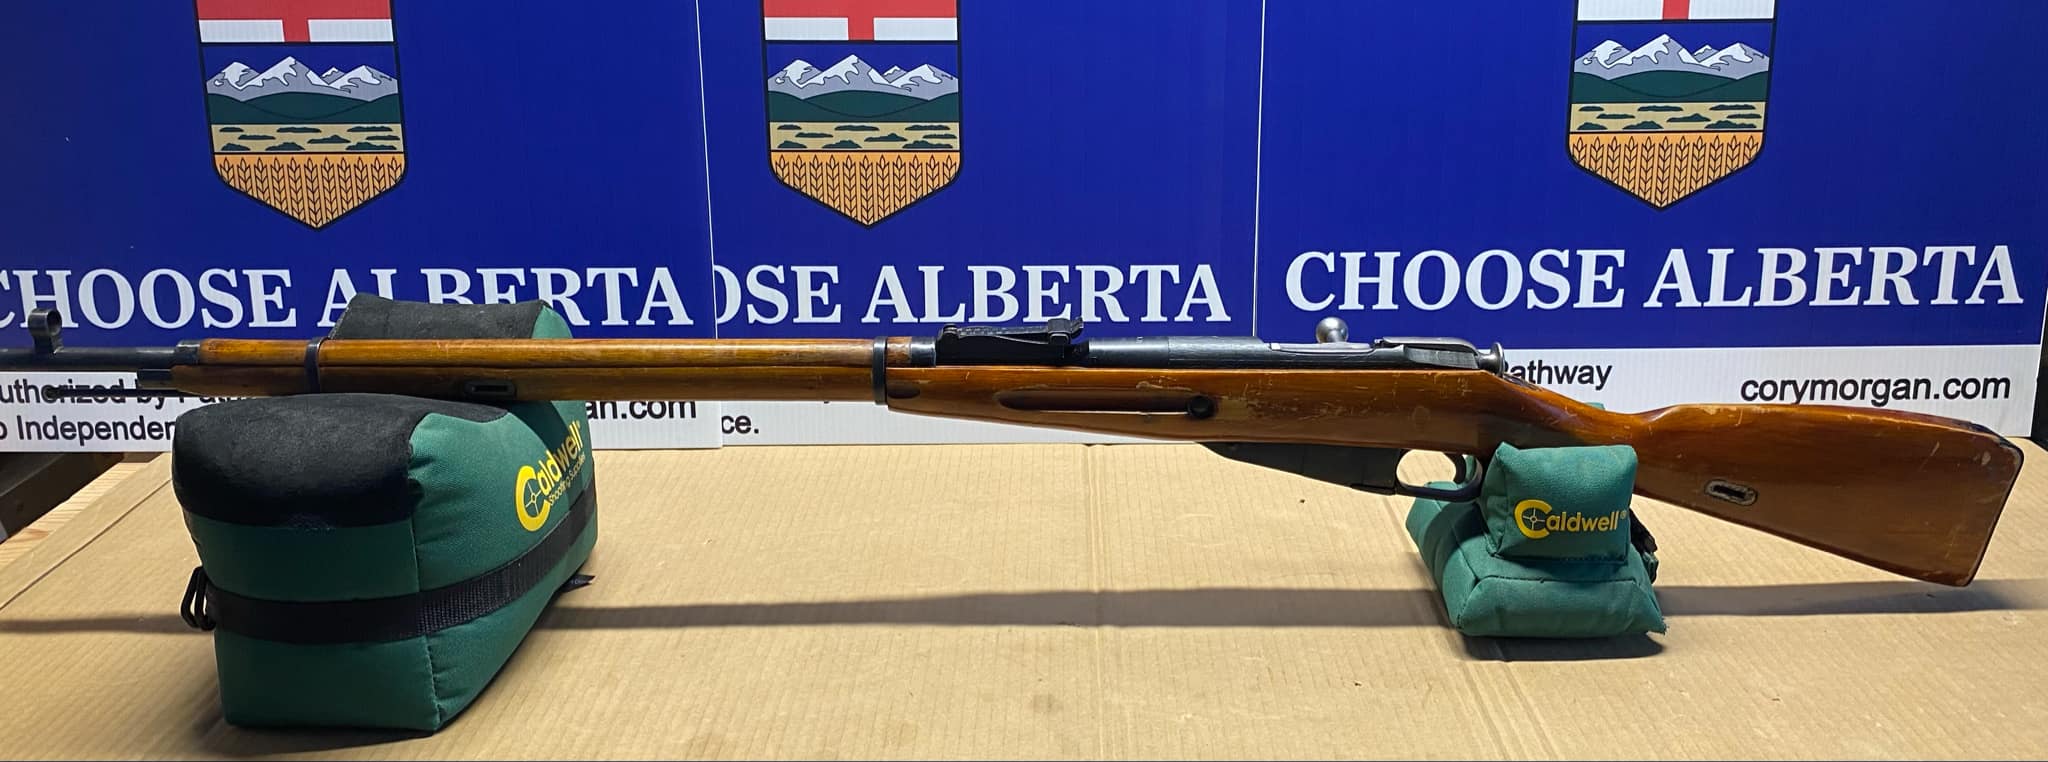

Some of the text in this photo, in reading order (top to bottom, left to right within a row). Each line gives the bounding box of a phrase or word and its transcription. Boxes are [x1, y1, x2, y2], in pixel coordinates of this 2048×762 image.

[861, 264, 1231, 324] ALBERTA
[1285, 245, 2024, 311] CHOOSE ALBERTA
[1740, 377, 2011, 407] corymorgan.com
